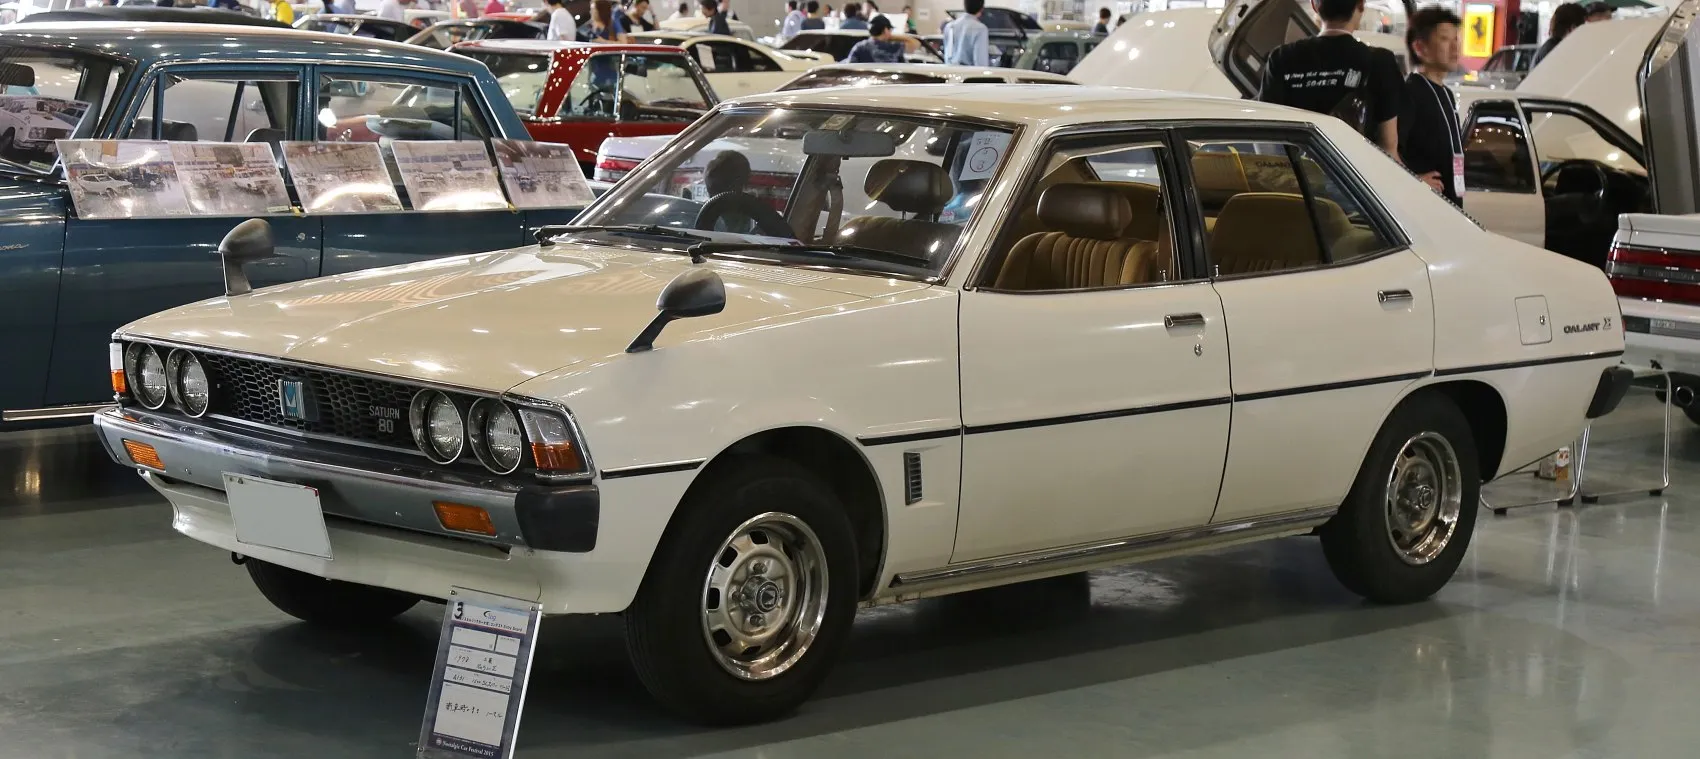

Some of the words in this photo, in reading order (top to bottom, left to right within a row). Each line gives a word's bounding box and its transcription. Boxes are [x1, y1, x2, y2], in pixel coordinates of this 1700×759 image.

[369, 405, 400, 420] SATURN
[379, 418, 394, 434] 80
[454, 601, 464, 619] 3
